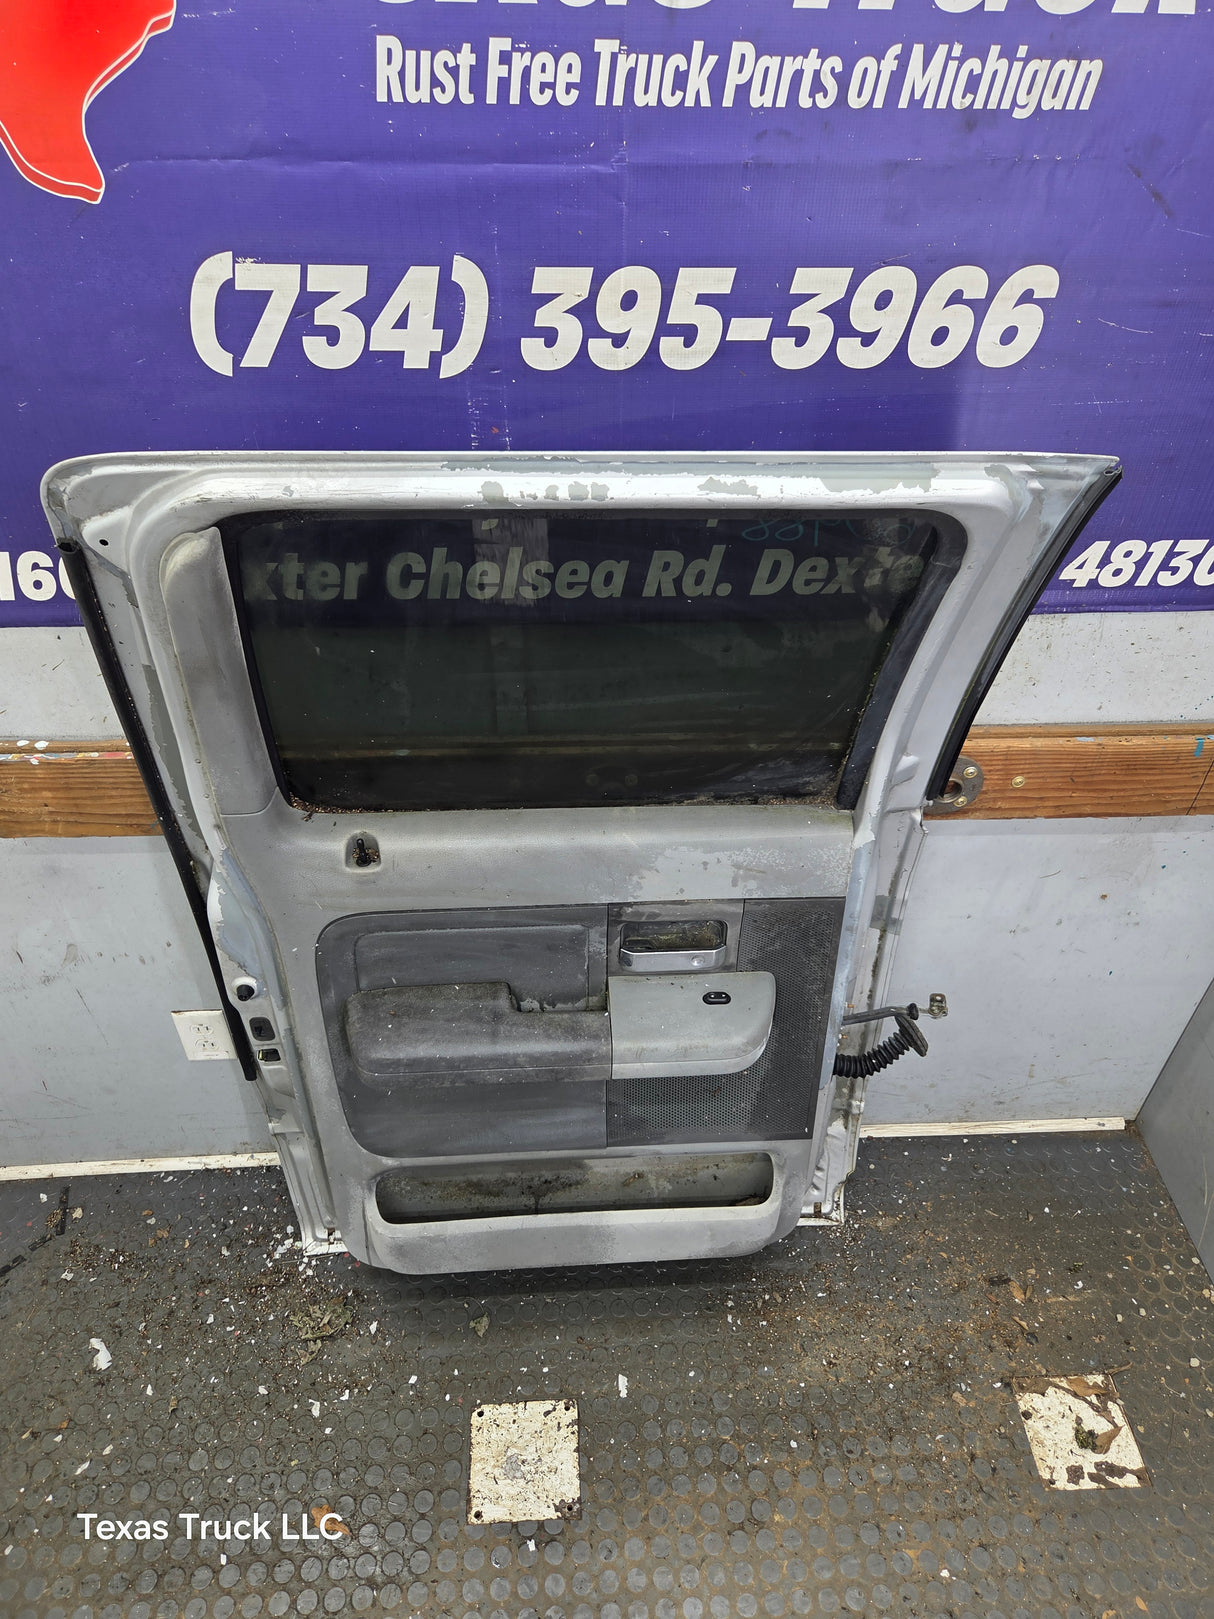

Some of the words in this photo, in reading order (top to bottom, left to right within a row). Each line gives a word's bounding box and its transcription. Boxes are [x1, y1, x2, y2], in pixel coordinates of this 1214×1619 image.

[375, 34, 477, 105] Rust
[485, 36, 582, 107] Free
[593, 38, 720, 108] Truck
[721, 40, 843, 110] Parts
[847, 43, 903, 110] of
[897, 42, 1104, 120] Michigan
[189, 250, 489, 379] (734)
[520, 264, 1060, 371] 395-3966
[385, 546, 630, 600] Chelsea
[642, 544, 733, 598] Rd.
